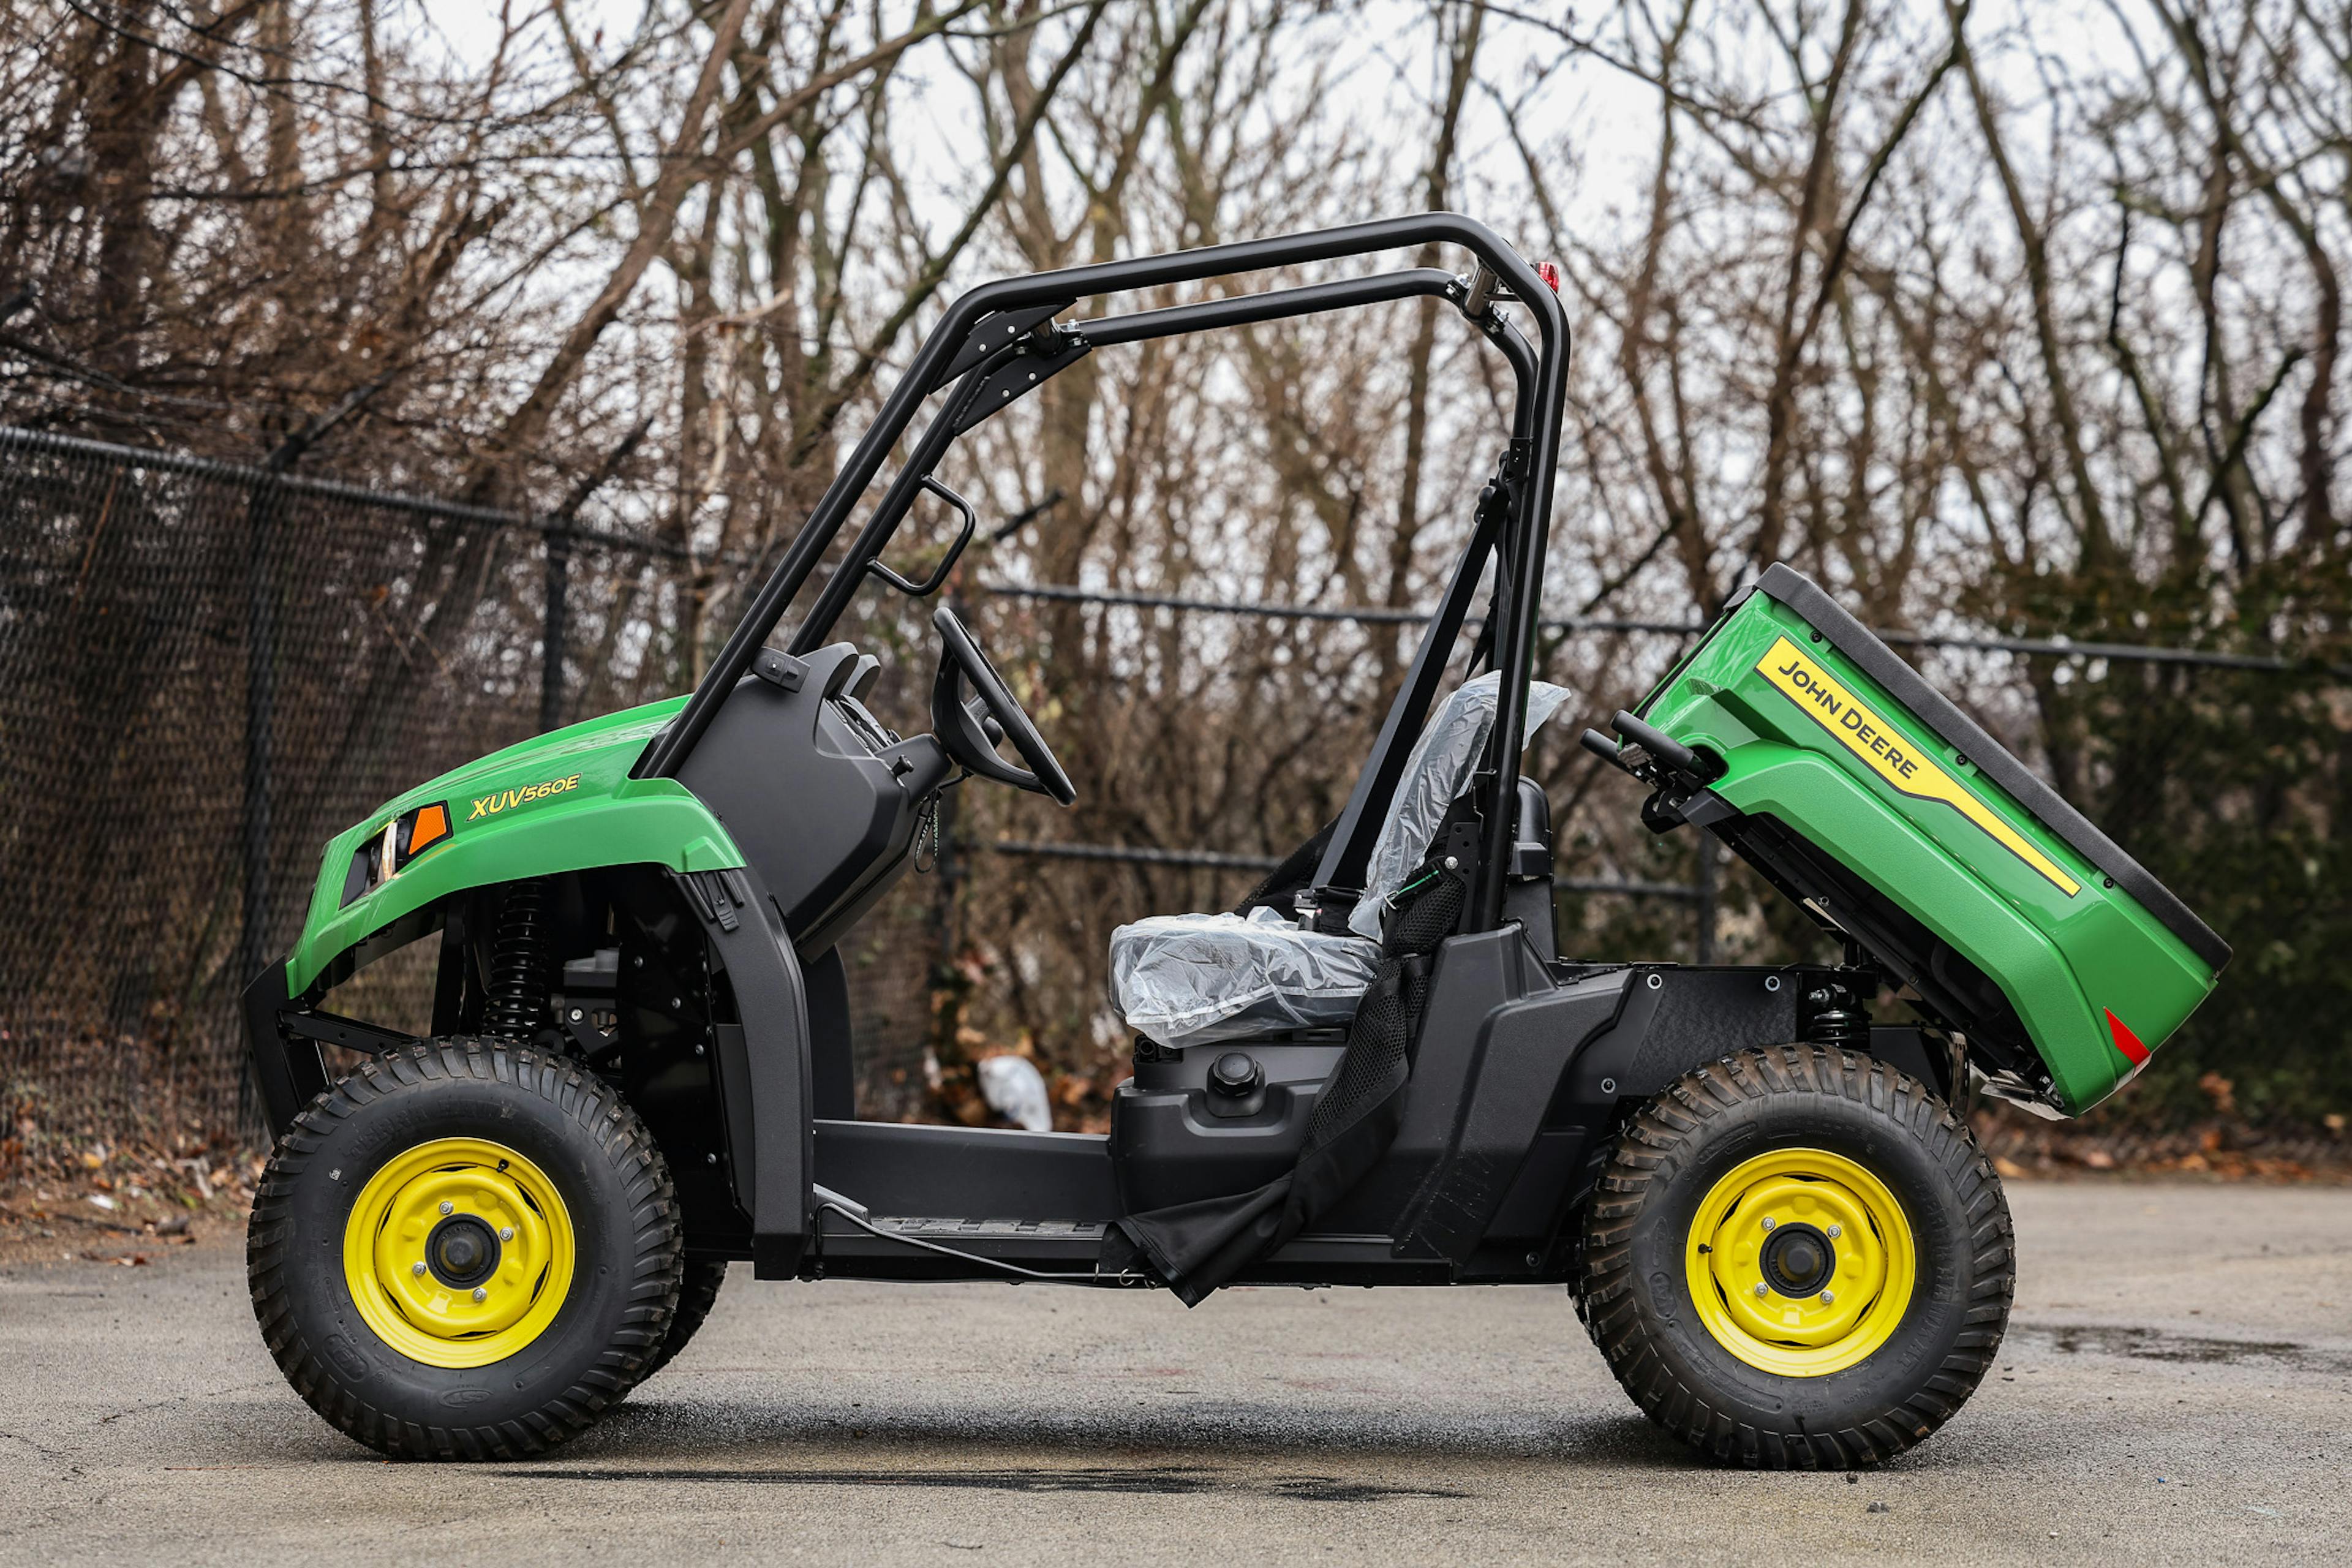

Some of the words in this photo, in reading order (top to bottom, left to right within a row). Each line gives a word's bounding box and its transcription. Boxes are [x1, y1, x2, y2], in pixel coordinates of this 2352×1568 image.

[1778, 661, 1842, 715] JOHN
[1840, 708, 1918, 779] DEERE
[466, 772, 582, 821] XUV560E
